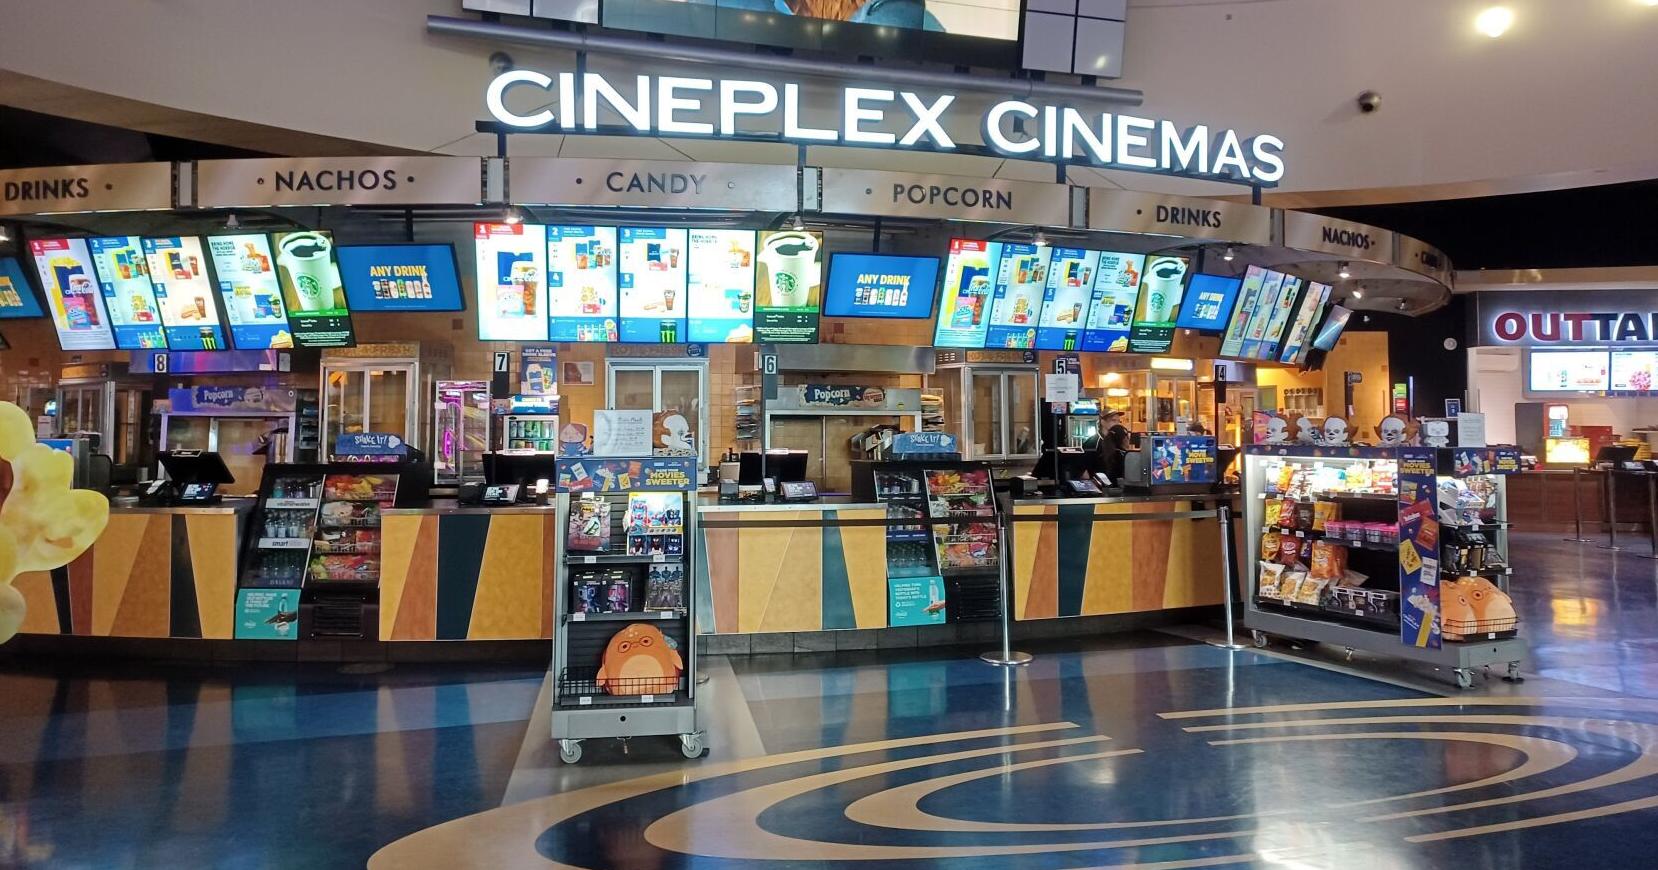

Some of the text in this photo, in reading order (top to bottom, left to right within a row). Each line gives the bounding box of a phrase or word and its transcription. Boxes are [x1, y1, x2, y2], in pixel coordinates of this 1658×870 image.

[486, 70, 1286, 182] CINEPLEX CINEMAS
[4, 178, 90, 201] DRINKS
[275, 169, 398, 193] NACHOS
[606, 171, 706, 195] CANDY
[893, 183, 1012, 211] POPCORN
[1156, 204, 1222, 229] DRINKS
[552, 227, 559, 236] 2
[1322, 226, 1370, 250] NACHOS
[370, 265, 428, 277] ANY DRINK
[856, 273, 912, 286] ANY DRINK
[1494, 312, 1658, 341] OUTTA
[156, 354, 165, 372] 8
[497, 353, 506, 371] 7
[766, 356, 775, 373] 6
[1057, 360, 1065, 374] 5
[1219, 366, 1225, 381] 4
[203, 390, 234, 402] Popcorn
[814, 388, 851, 401] Popcorn
[645, 478, 690, 486] SWEETER
[650, 471, 685, 479] MOVIES
